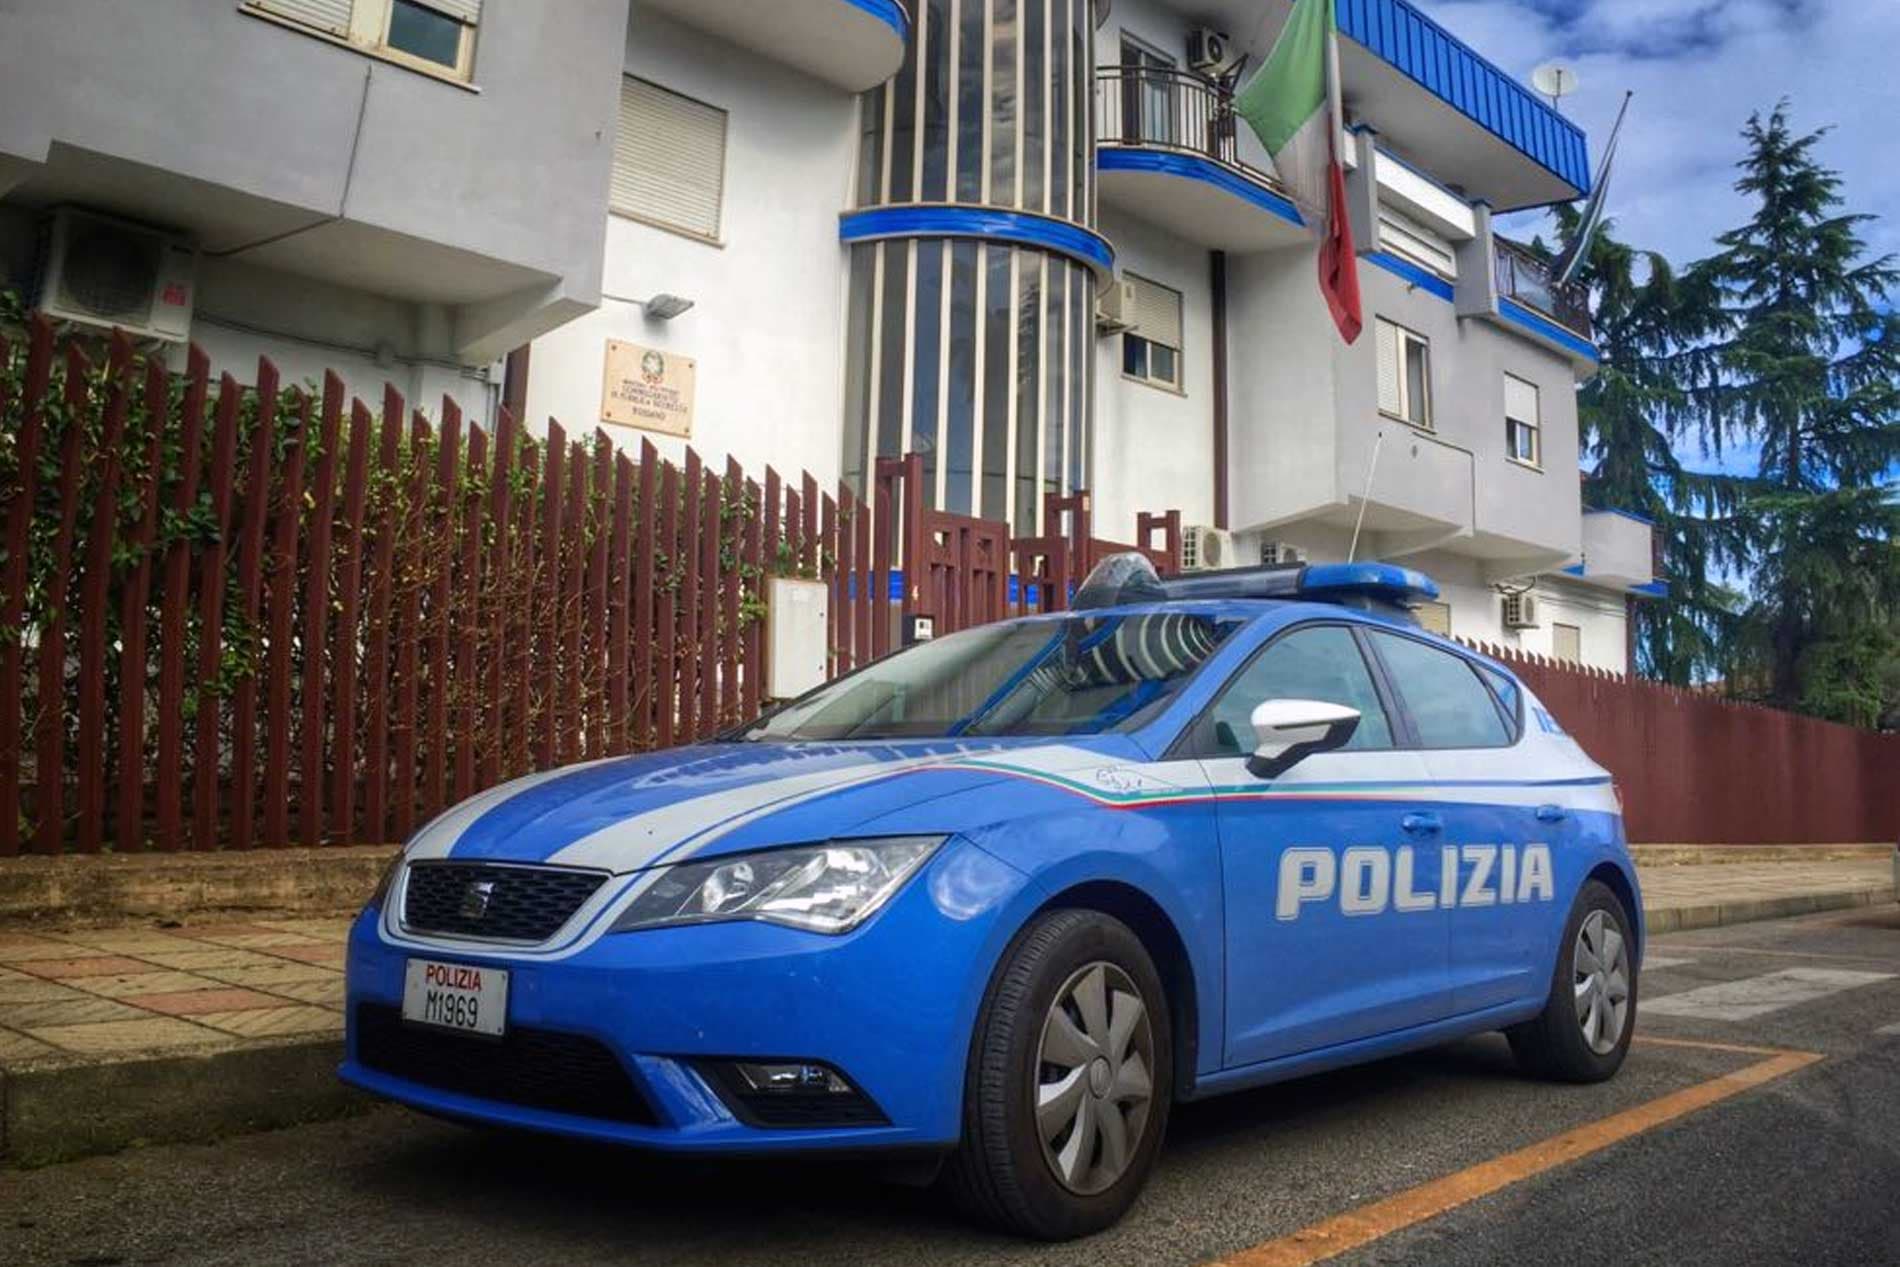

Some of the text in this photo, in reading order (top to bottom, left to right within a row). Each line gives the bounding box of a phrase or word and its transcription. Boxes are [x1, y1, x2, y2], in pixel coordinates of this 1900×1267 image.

[1275, 843, 1554, 921] POLIZIA
[426, 964, 482, 992] POLIZIA
[425, 989, 478, 1028] M1969
